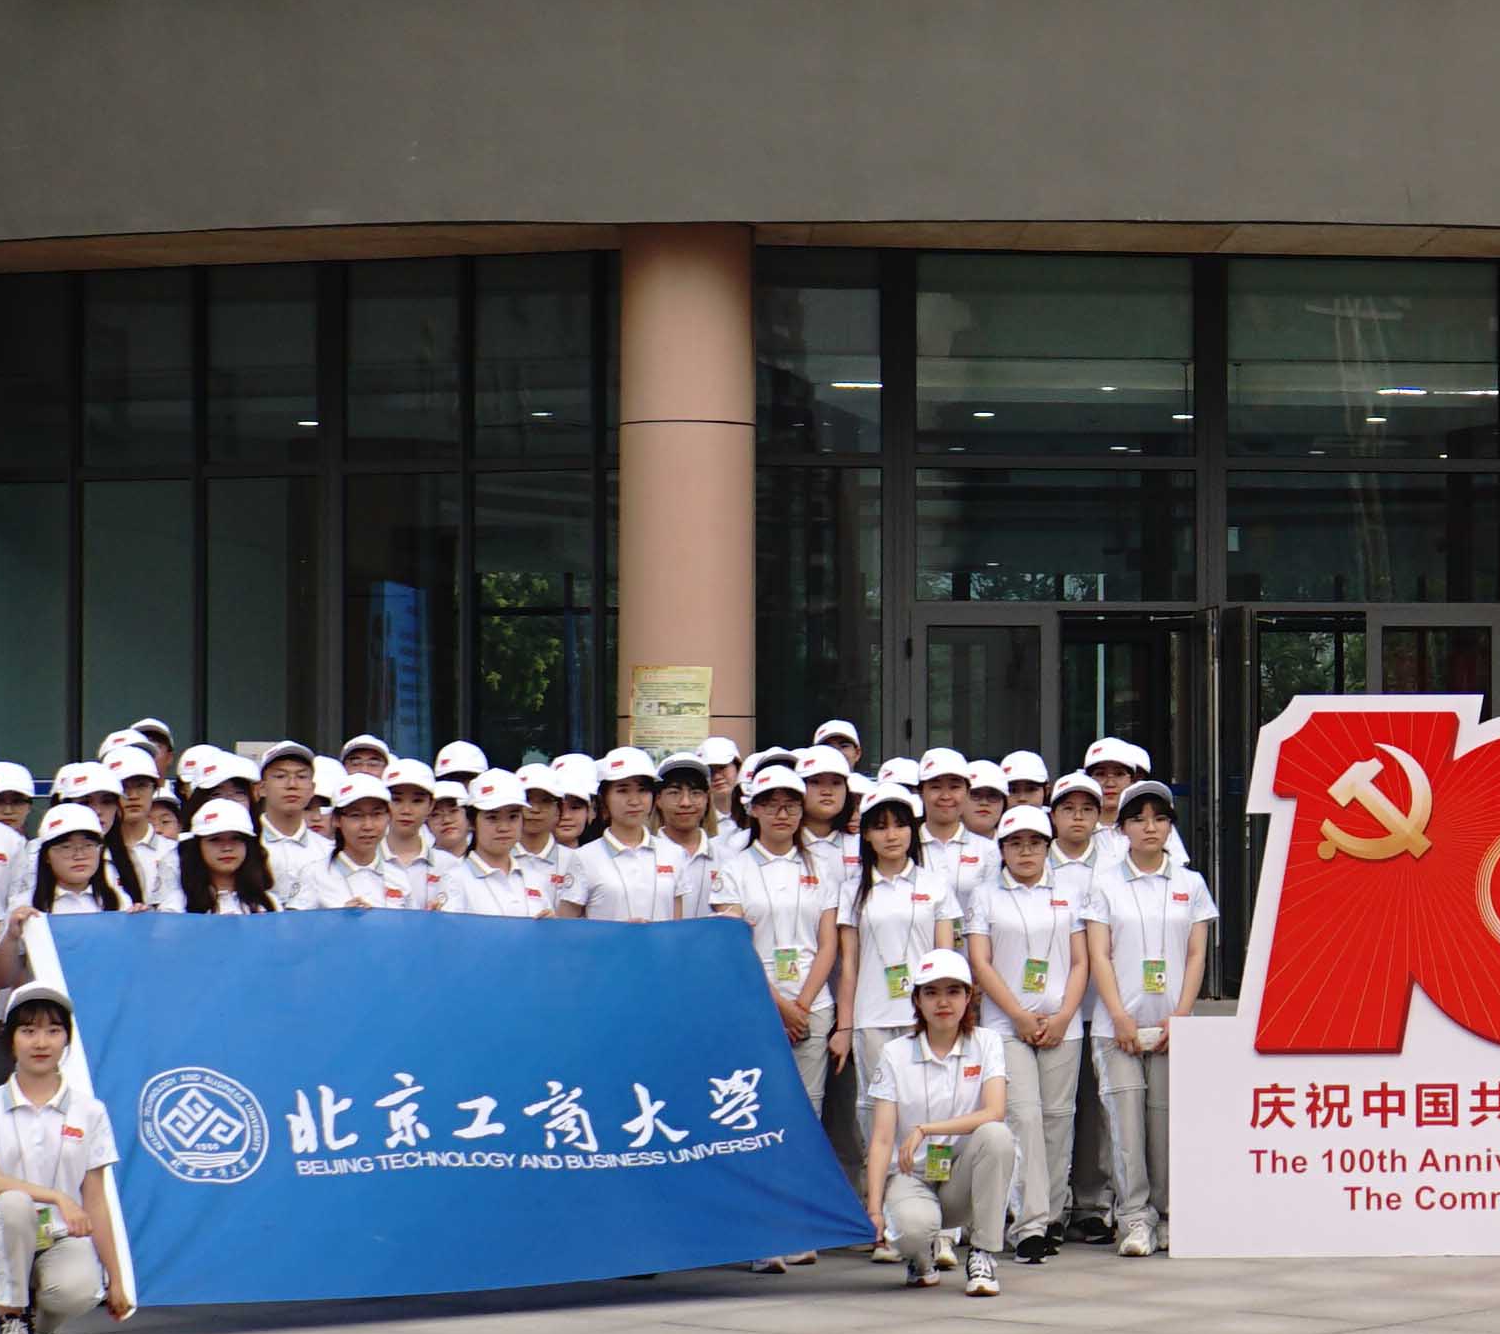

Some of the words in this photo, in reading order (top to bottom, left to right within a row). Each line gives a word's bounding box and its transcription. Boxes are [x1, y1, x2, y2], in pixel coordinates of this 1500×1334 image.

[296, 1156, 374, 1176] BEIJING
[375, 1151, 516, 1171] TECHNOLOGY
[519, 1154, 563, 1170] AND
[565, 1150, 667, 1169] BUSINESS
[668, 1129, 786, 1164] UNIVERSITY
[1249, 1149, 1308, 1174] The
[1321, 1148, 1407, 1174] 100th
[1343, 1186, 1402, 1211] The
